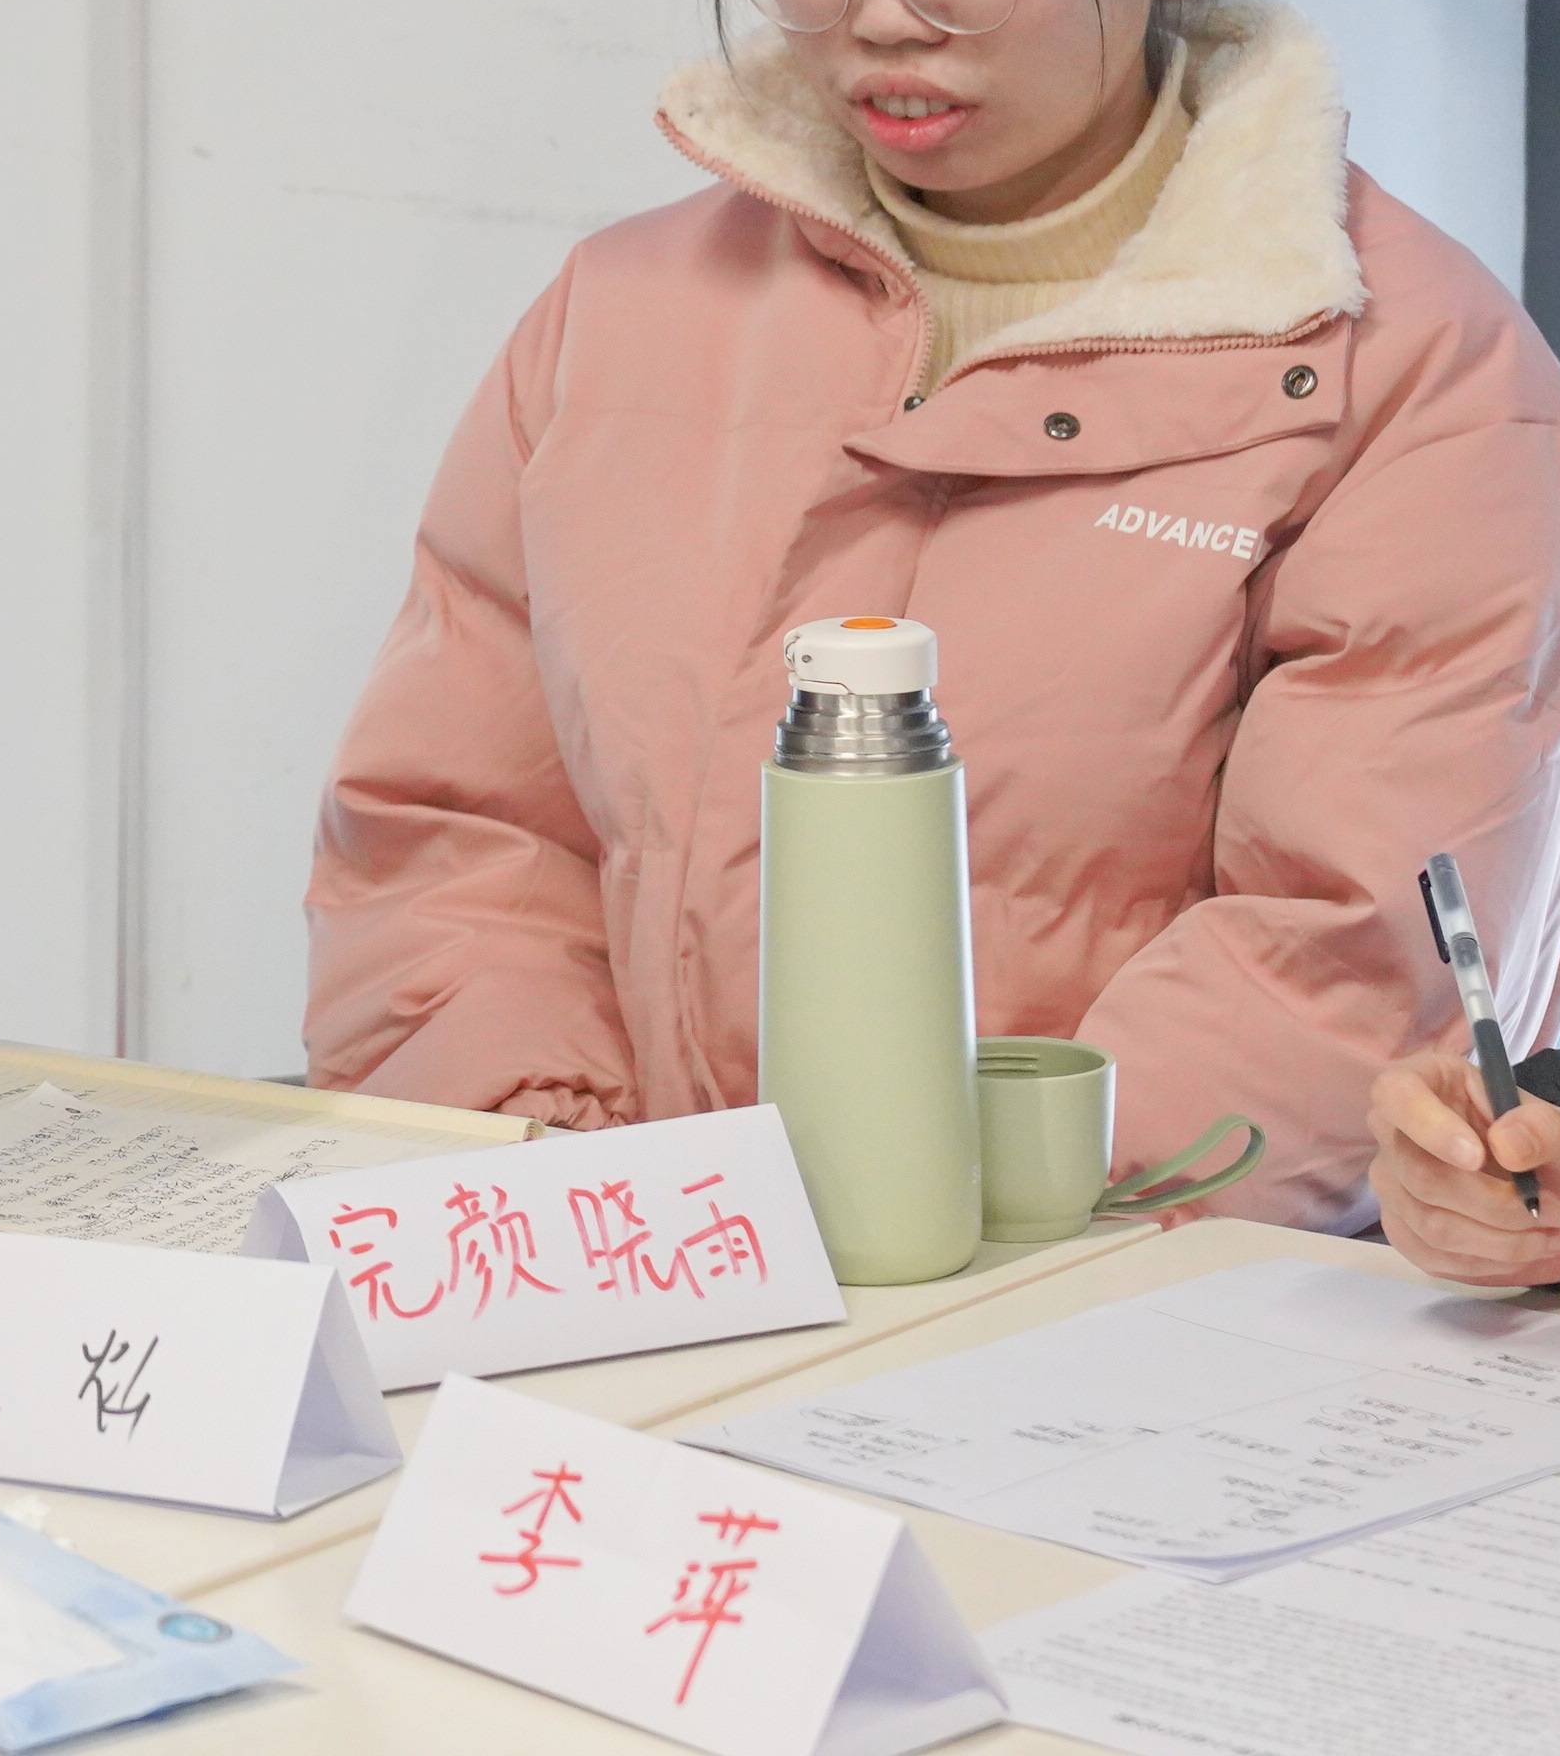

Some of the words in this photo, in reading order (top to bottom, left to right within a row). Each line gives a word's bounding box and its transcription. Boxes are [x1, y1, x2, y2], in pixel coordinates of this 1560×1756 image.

[1093, 503, 1259, 561] ADVANCE
[328, 1172, 769, 1322] 完颜晓雨
[479, 1460, 782, 1707] 李萍
